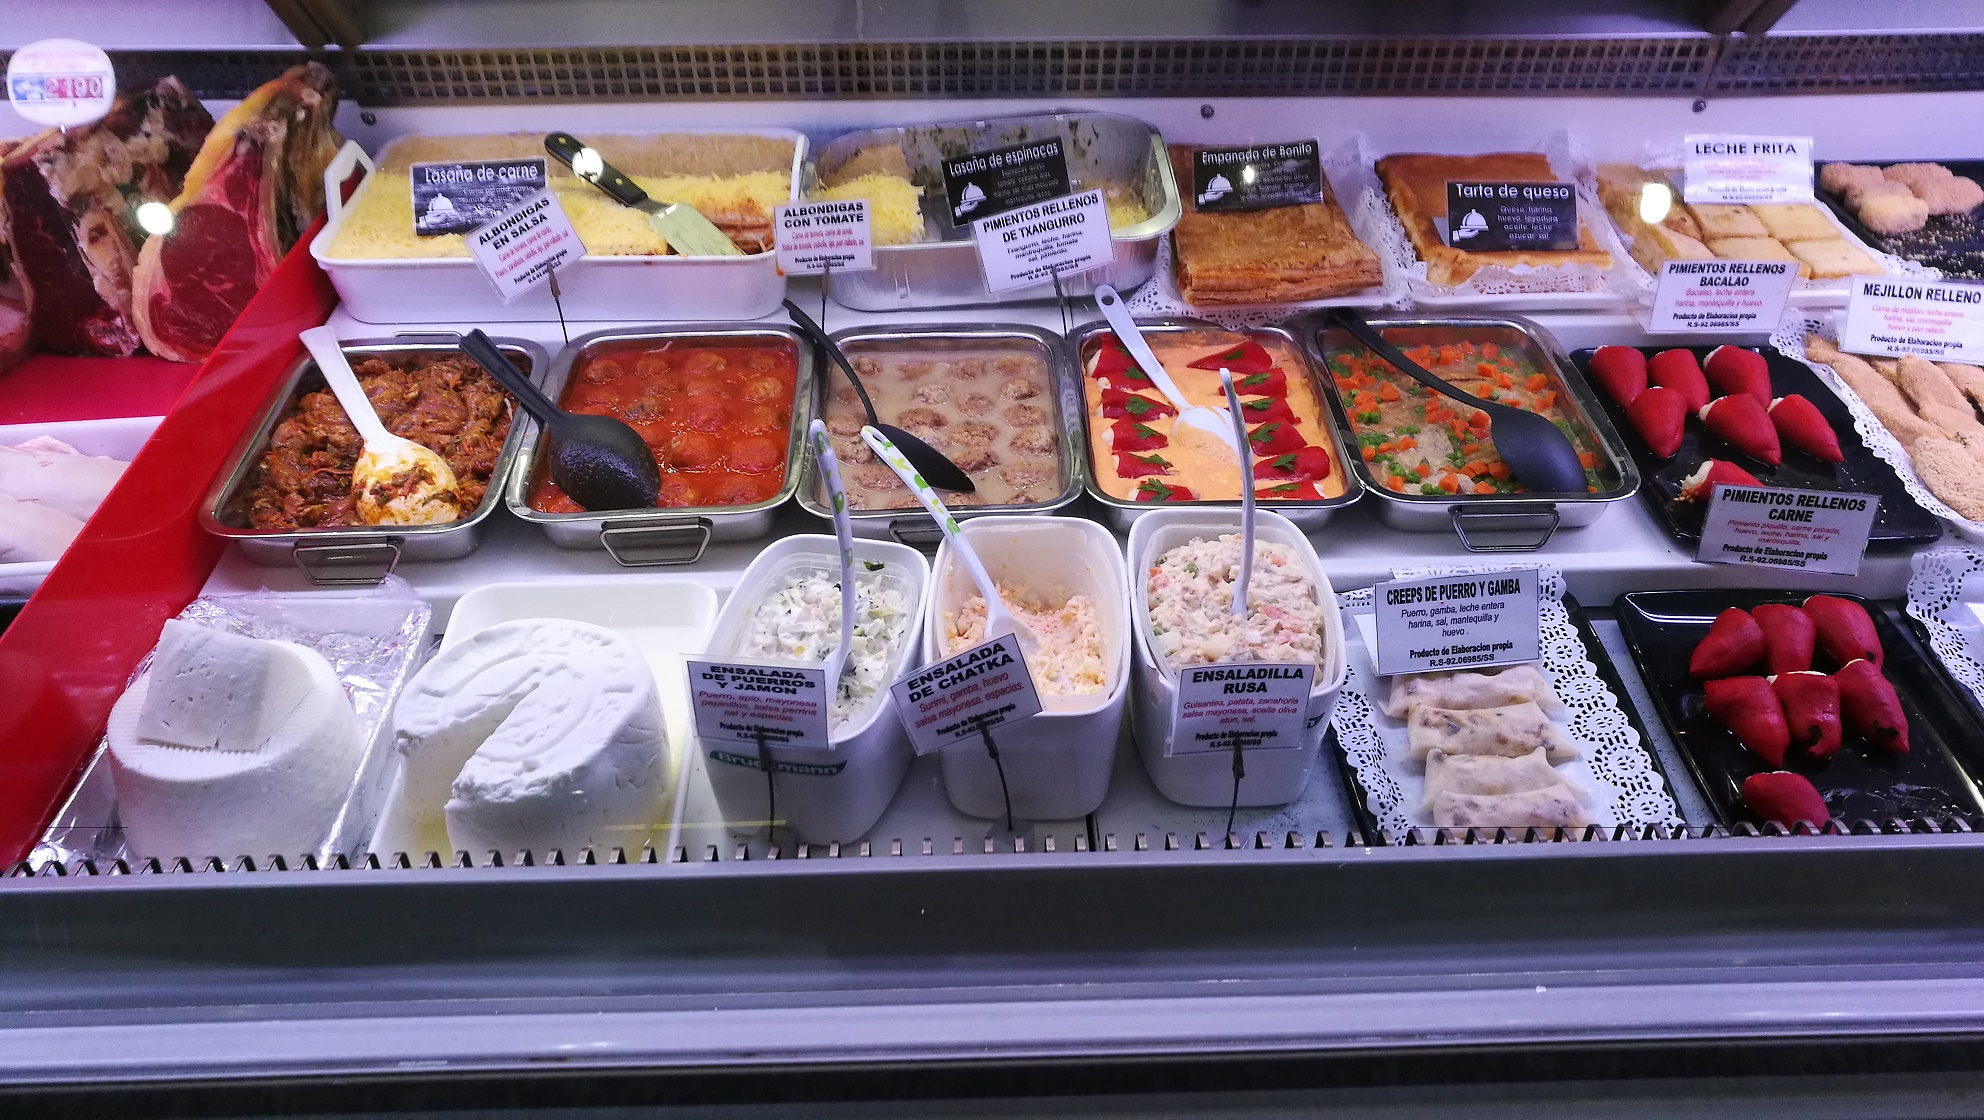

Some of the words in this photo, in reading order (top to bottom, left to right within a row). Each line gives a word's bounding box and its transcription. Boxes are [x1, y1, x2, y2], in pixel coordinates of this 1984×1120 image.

[1202, 149, 1259, 165] Empanada
[1263, 146, 1276, 160] de
[1279, 142, 1312, 157] Bonito
[1695, 142, 1747, 154] LECHE
[1753, 142, 1797, 154] FRITA
[949, 156, 987, 177] Lasaña
[989, 152, 1003, 168] de
[1005, 142, 1059, 166] espinacas
[425, 165, 473, 184] Lasaña
[477, 164, 494, 181] de
[499, 164, 538, 182] carne
[1456, 184, 1493, 198] Tarta
[1499, 184, 1518, 198] de
[1523, 186, 1569, 201] queso
[784, 202, 863, 217] ALBONDIGAS
[983, 208, 1040, 233] PIMIENTOS
[1042, 193, 1099, 217] RELLENOS
[478, 197, 550, 245] ALBONDIGAS
[784, 219, 810, 228] CON
[814, 213, 864, 225] TOMATE
[1003, 230, 1017, 243] DE
[1019, 213, 1085, 238] TXANGURRO
[492, 235, 510, 250] EN
[511, 213, 547, 238] SALSA
[1669, 263, 1726, 274] PIMIENTOS
[1728, 263, 1786, 274] RELLENOS
[1700, 276, 1749, 287] BACALAO
[1863, 283, 1922, 300] MEJILLON
[1926, 288, 1981, 304] RELLENO
[1871, 334, 1897, 343] Producto
[1899, 336, 1905, 344] de
[1908, 337, 1942, 346] Elaboracion
[1943, 340, 1962, 349] propia
[1722, 489, 1794, 506] PIMIENTOS
[1796, 494, 1867, 511] RELLENOS
[1728, 519, 1760, 528] Pimiento
[1768, 509, 1814, 522] CARNE
[1722, 544, 1753, 554] Producto
[1754, 546, 1762, 555] de
[1764, 547, 1804, 558] Elaboracion
[1805, 551, 1828, 561] propia
[1387, 587, 1422, 606] CREEPS
[1425, 586, 1437, 601] DE
[1440, 582, 1477, 601] PUERRO
[1479, 581, 1486, 597] Y
[1488, 578, 1521, 596] GAMBA
[1401, 609, 1428, 618] Puerro,
[1430, 605, 1458, 617] gamba,
[1459, 603, 1480, 612] leche
[1481, 601, 1505, 610] entera
[1408, 619, 1433, 629] harina,
[1436, 617, 1449, 627] sal,
[1451, 613, 1492, 627] mantequilla
[1493, 614, 1499, 622] y
[1442, 628, 1465, 637] huevo
[1409, 647, 1440, 659] Producto
[1442, 647, 1450, 656] de
[1451, 643, 1491, 655] Elaboracion
[1492, 640, 1513, 652] propia
[907, 642, 1006, 691] ENSALADA
[1429, 654, 1495, 667] R.S-92.06985/SS
[710, 666, 806, 680] ENSALADA
[908, 685, 934, 703] DE
[938, 653, 1014, 690] CHATKA
[1193, 668, 1304, 683] ENSALADILLA
[731, 675, 816, 689] PUERROS
[734, 683, 797, 695] JAMON
[1223, 682, 1267, 694] RUSA
[699, 691, 735, 701] Puerro,
[766, 696, 817, 708] mayonesa
[919, 694, 949, 713] Surimi,
[950, 682, 981, 703] gamba,
[982, 671, 1009, 687] huevo
[754, 704, 780, 713] salsa
[783, 706, 817, 716] perrins
[1227, 698, 1256, 707] patata,
[1258, 697, 1299, 705] zanahoria
[915, 711, 941, 729] salsa
[939, 696, 984, 718] mayonesa,
[1182, 710, 1204, 718] salsa
[1205, 708, 1249, 717] mayonesa,
[1278, 706, 1297, 714] oliva
[1196, 732, 1219, 741] Producto
[1260, 730, 1278, 738] propia
